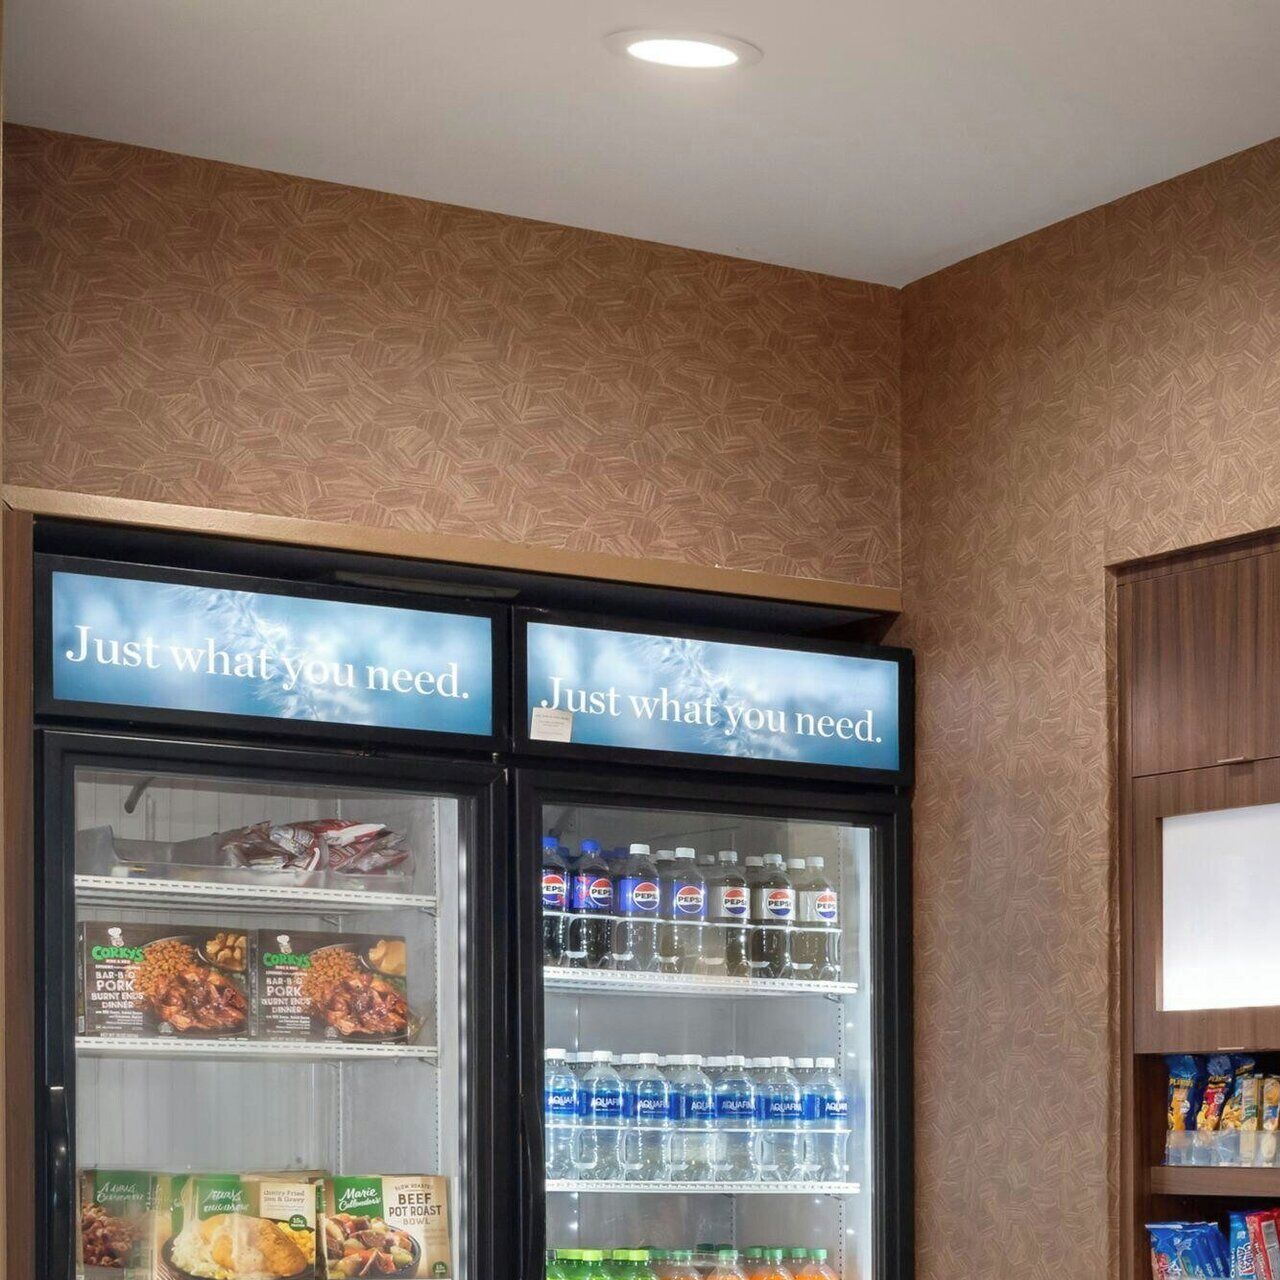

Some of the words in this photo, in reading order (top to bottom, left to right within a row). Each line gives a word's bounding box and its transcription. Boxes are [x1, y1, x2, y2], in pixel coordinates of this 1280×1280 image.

[65, 624, 160, 669] Just
[169, 638, 273, 681] what
[281, 653, 355, 691] you
[365, 662, 470, 700] need.
[540, 676, 622, 717] Just
[628, 687, 719, 726] what
[725, 703, 787, 736] you
[795, 709, 883, 744] need.
[96, 979, 135, 992] PORK
[266, 986, 302, 997] PORK
[101, 1001, 134, 1009] DINNER
[340, 1186, 378, 1201] Marie
[398, 1193, 432, 1205] BEEF
[388, 1206, 409, 1217] POT
[410, 1205, 442, 1216] ROAST
[403, 1217, 431, 1225] BOWL
